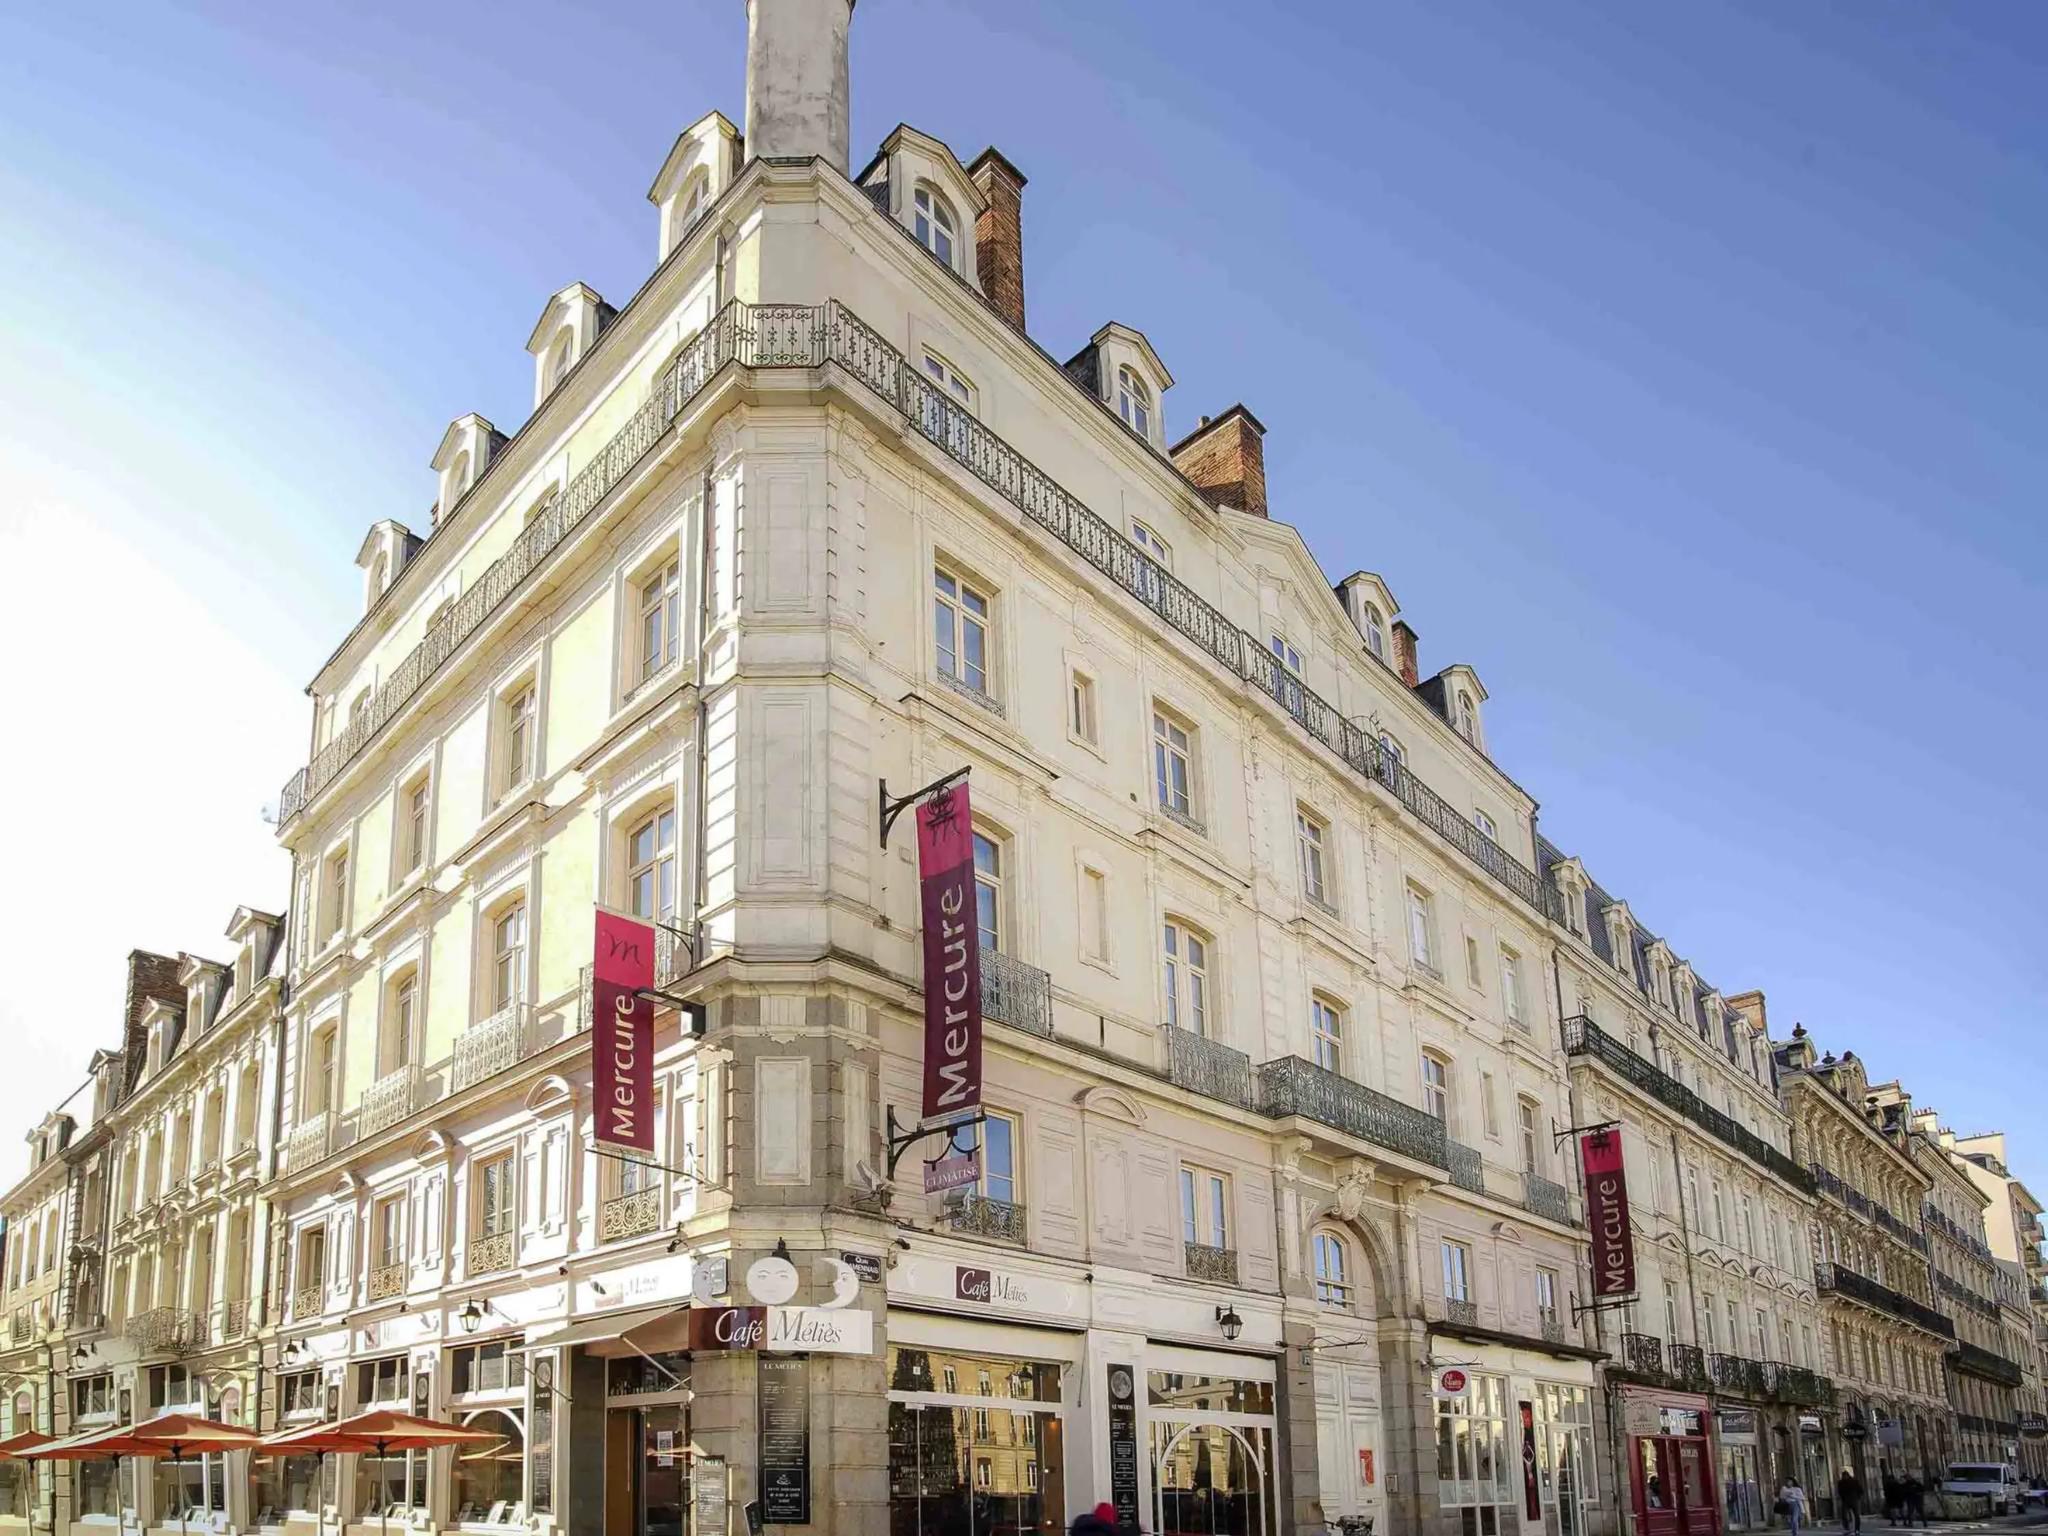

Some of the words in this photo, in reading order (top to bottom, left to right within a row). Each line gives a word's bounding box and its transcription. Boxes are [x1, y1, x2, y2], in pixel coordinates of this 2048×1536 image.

[937, 883, 969, 1107] Mercure
[612, 994, 635, 1138] Mercure
[960, 1270, 989, 1300] Café
[1600, 1177, 1626, 1292] Mercure
[715, 1309, 764, 1347] Café
[771, 1310, 842, 1349] Méliès
